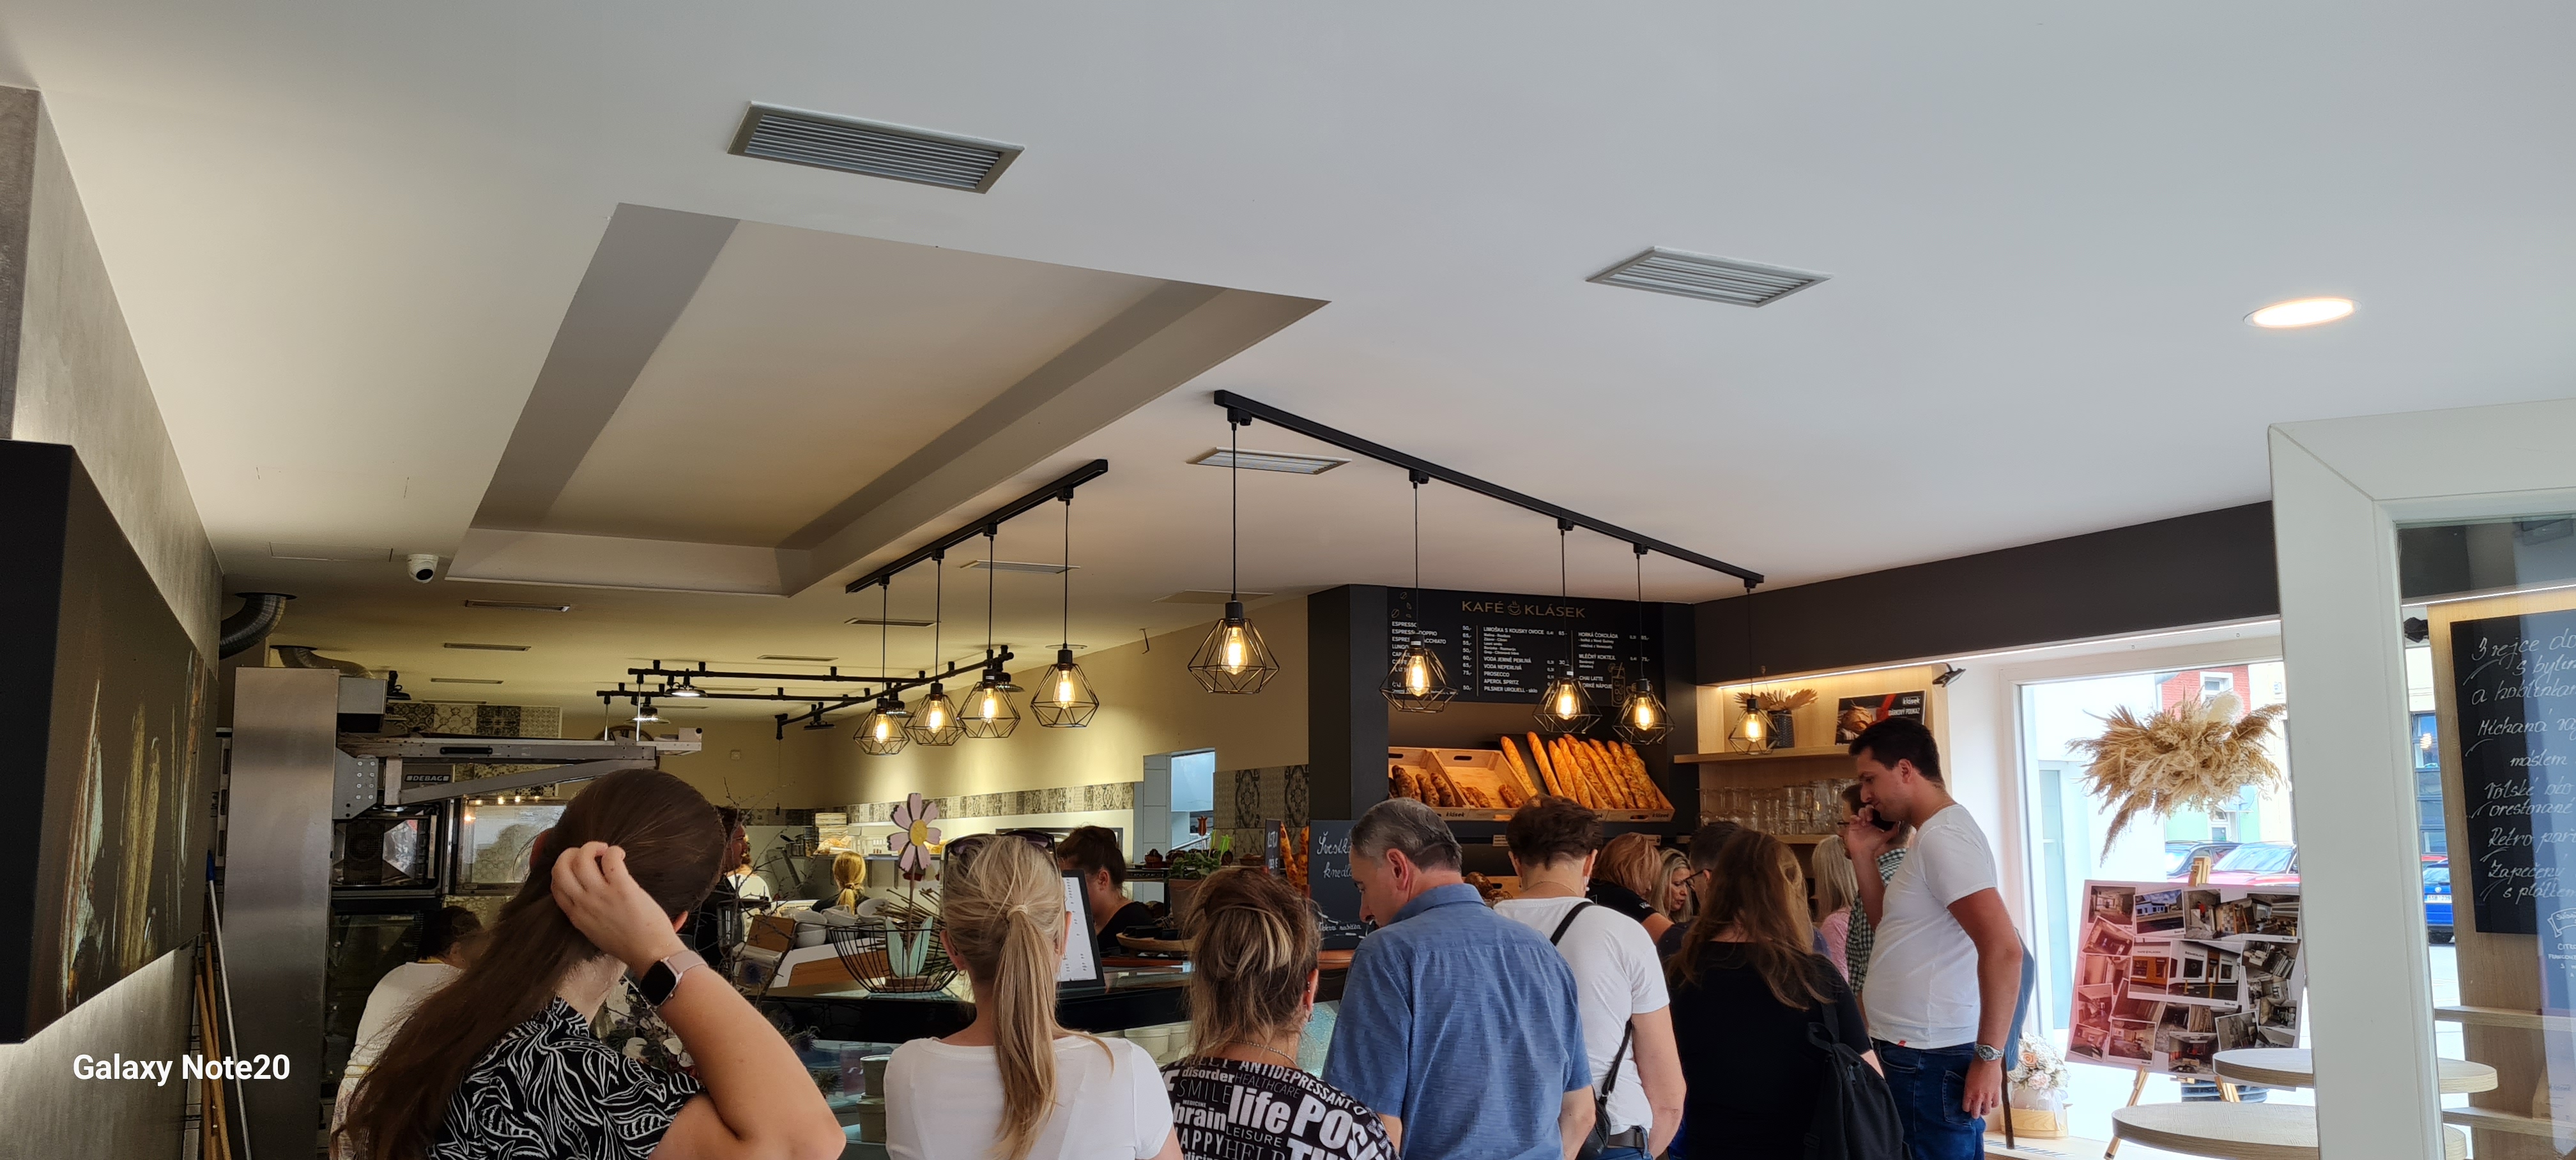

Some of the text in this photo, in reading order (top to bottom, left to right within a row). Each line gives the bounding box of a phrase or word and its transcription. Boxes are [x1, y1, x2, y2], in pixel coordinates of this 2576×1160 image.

[1462, 600, 1586, 618] KAFÉ KLÁSEK
[1182, 1066, 1235, 1084] disorder
[1234, 1072, 1301, 1099] HEALTHCARE
[1177, 1079, 1232, 1105] SMILE
[1182, 1099, 1207, 1108] MEDICINE
[1174, 1102, 1227, 1131] brain
[1227, 1085, 1291, 1134] life
[1225, 1125, 1282, 1148] LEISURE
